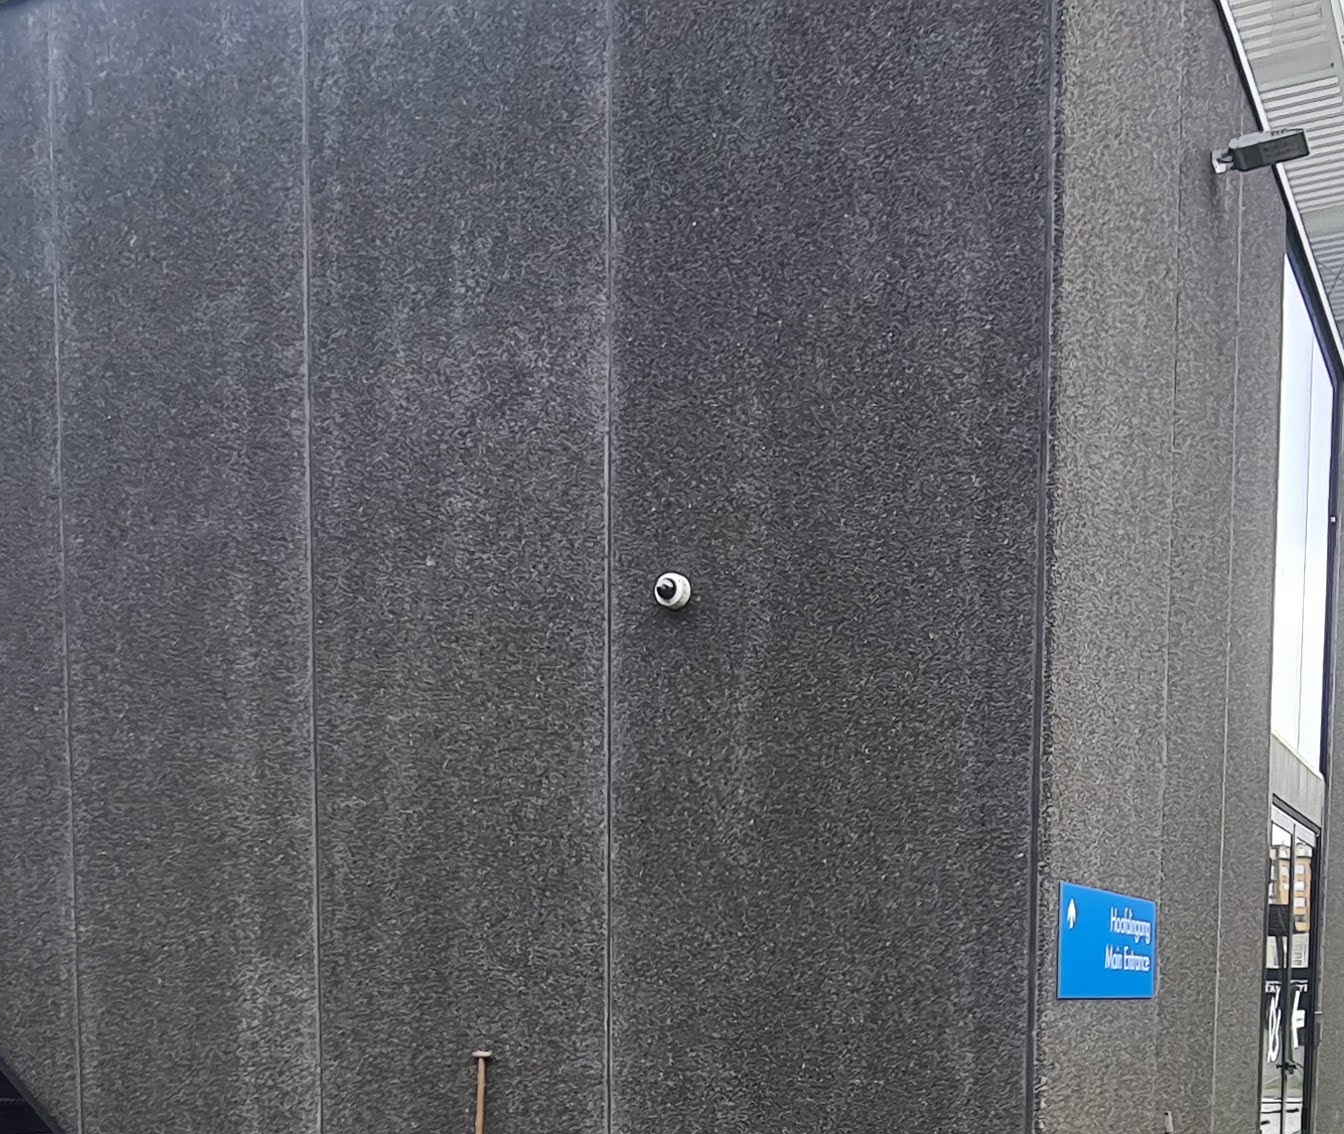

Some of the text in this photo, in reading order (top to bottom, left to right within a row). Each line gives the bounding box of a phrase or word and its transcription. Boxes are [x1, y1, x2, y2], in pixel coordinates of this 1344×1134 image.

[1110, 906, 1151, 945] Hoofdingang
[1104, 944, 1151, 972] Main Entrance
